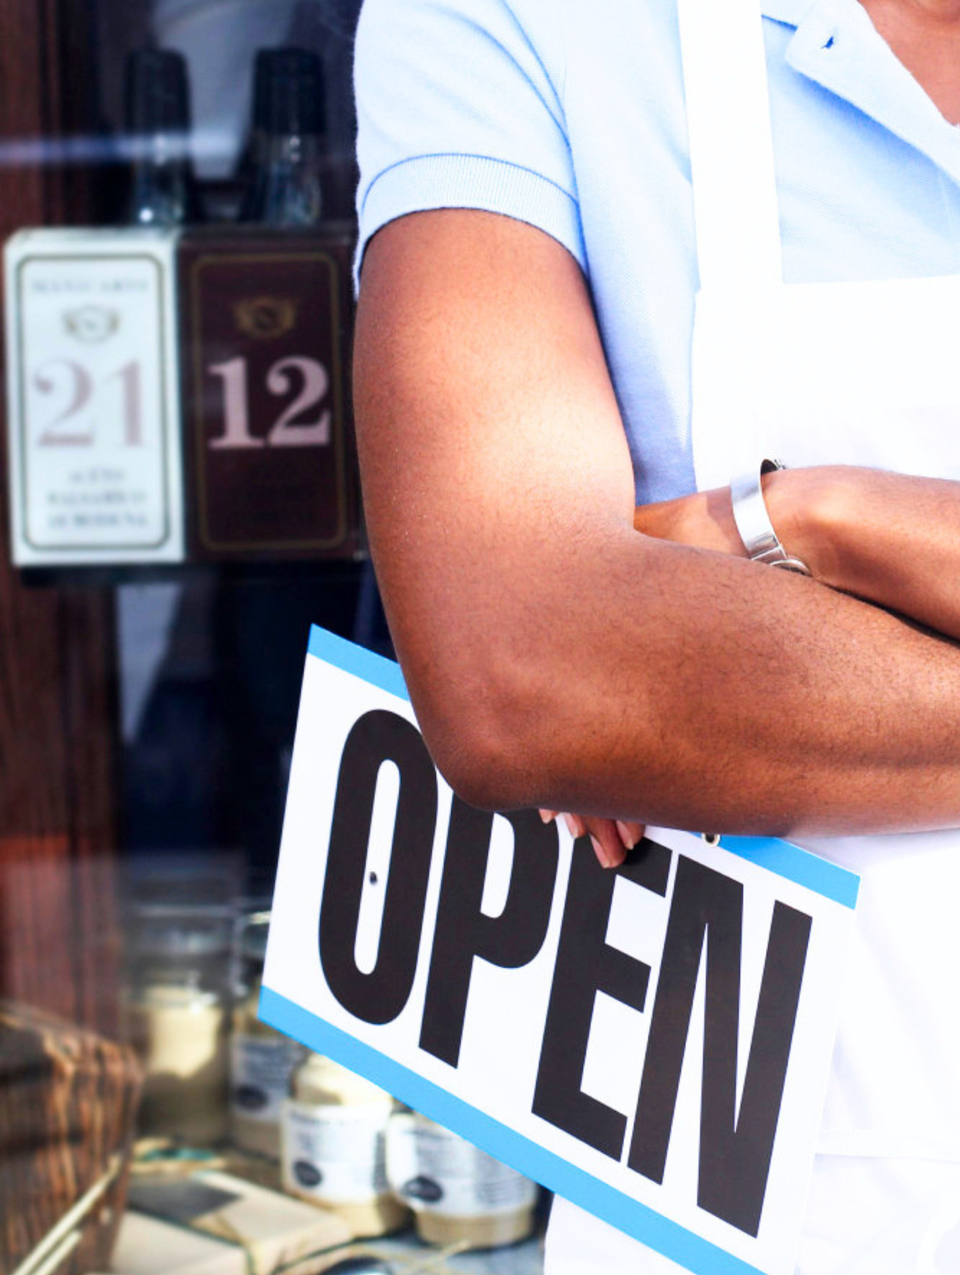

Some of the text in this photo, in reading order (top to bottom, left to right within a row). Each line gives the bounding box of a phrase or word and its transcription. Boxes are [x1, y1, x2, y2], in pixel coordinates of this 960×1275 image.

[33, 358, 144, 448] 21
[208, 354, 331, 450] 12
[318, 708, 813, 1239] OPEN
